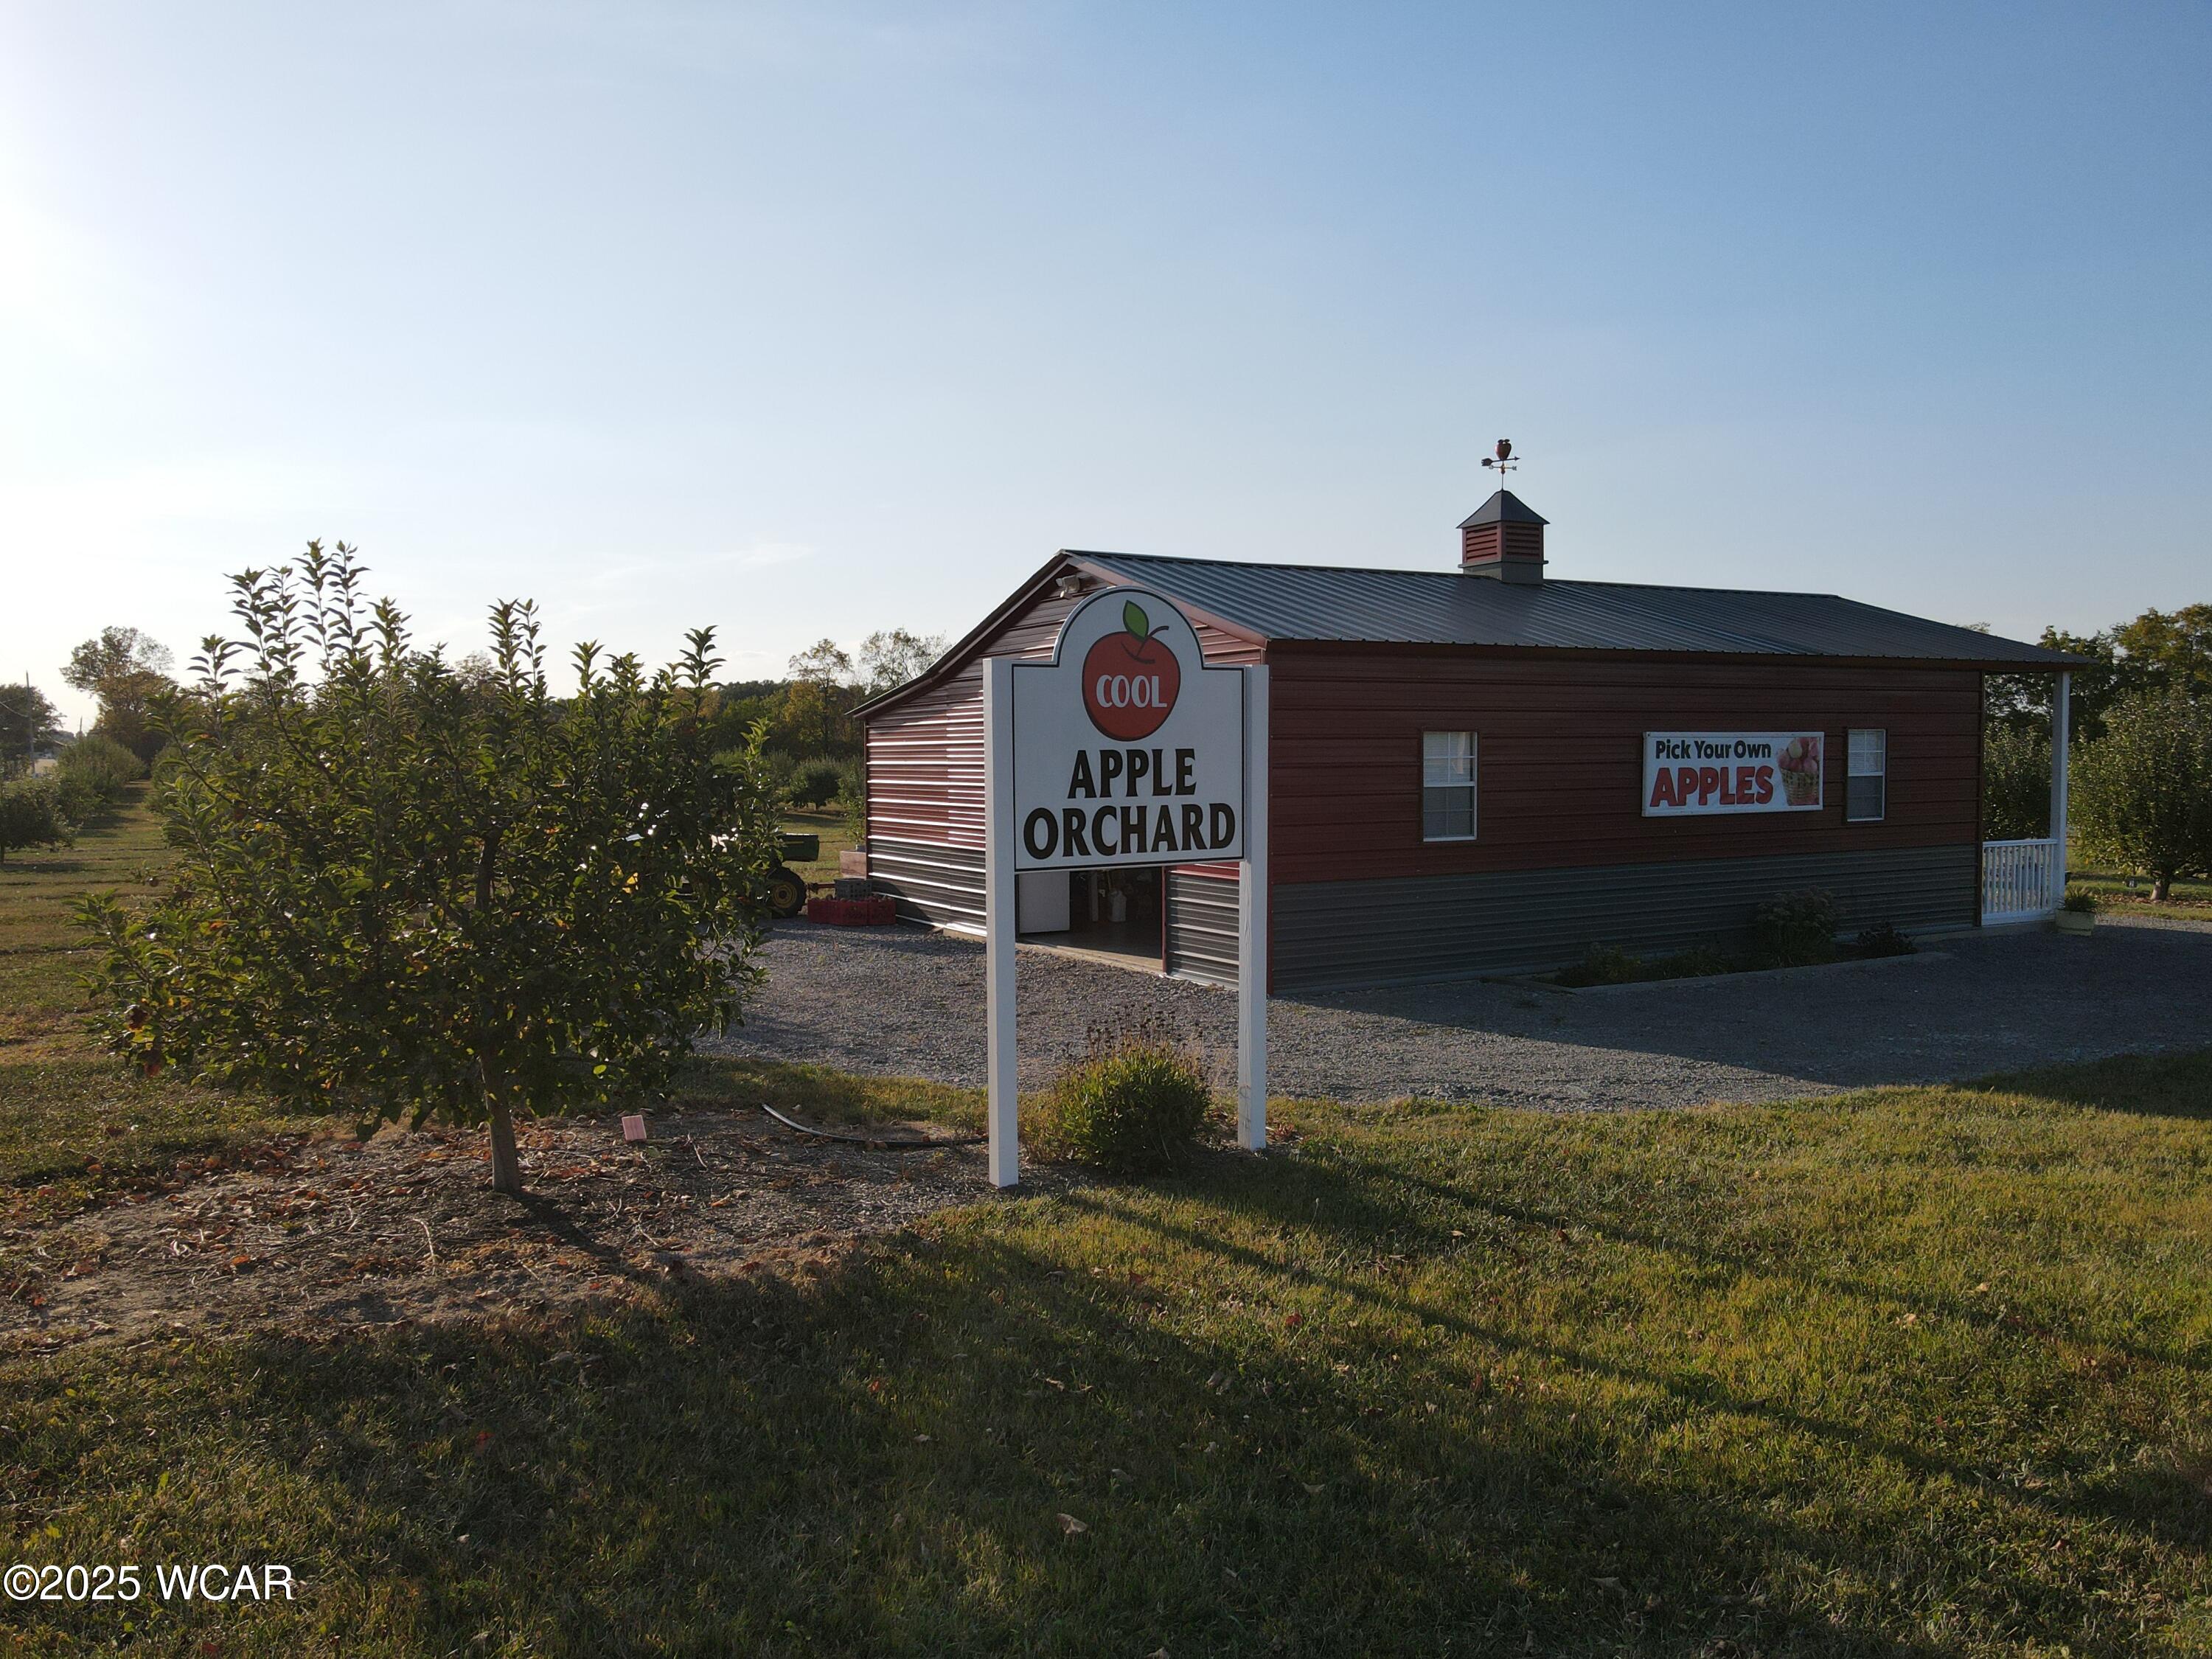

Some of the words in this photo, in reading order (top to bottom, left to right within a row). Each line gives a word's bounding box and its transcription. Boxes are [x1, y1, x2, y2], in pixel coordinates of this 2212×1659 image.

[1096, 675, 1167, 708] COOL
[1655, 739, 1691, 759] Pick
[1694, 740, 1732, 759] Your
[1733, 740, 1771, 759] Own
[1067, 748, 1197, 799] APPLE
[1649, 765, 1774, 807] APPLES
[1023, 802, 1236, 860] ORCHARD
